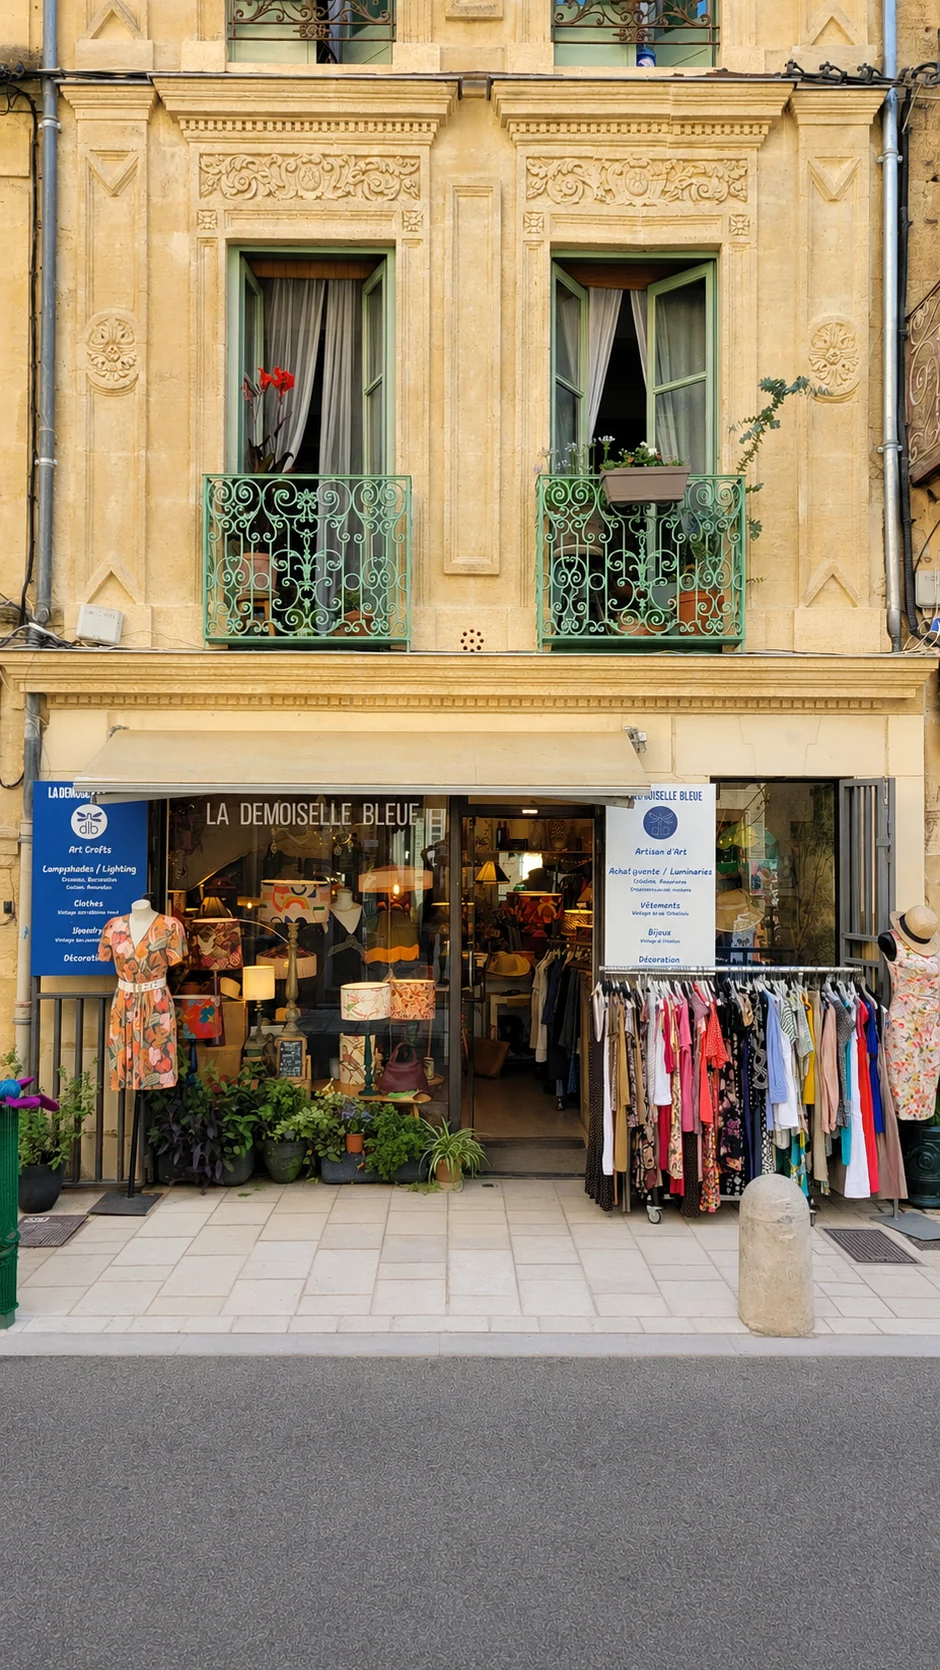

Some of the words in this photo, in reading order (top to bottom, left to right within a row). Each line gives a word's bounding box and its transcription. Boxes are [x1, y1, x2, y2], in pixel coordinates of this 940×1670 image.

[48, 786, 59, 799] LA
[679, 790, 703, 801] BLEUE
[206, 803, 229, 825] LA
[240, 803, 352, 825] DEMOISELLE
[363, 803, 420, 825] BLEUE
[68, 846, 83, 854] Art
[102, 865, 137, 875] Lighting
[74, 900, 104, 908] Clothes
[640, 901, 681, 909] Vêtements
[638, 956, 681, 964] Décoration
